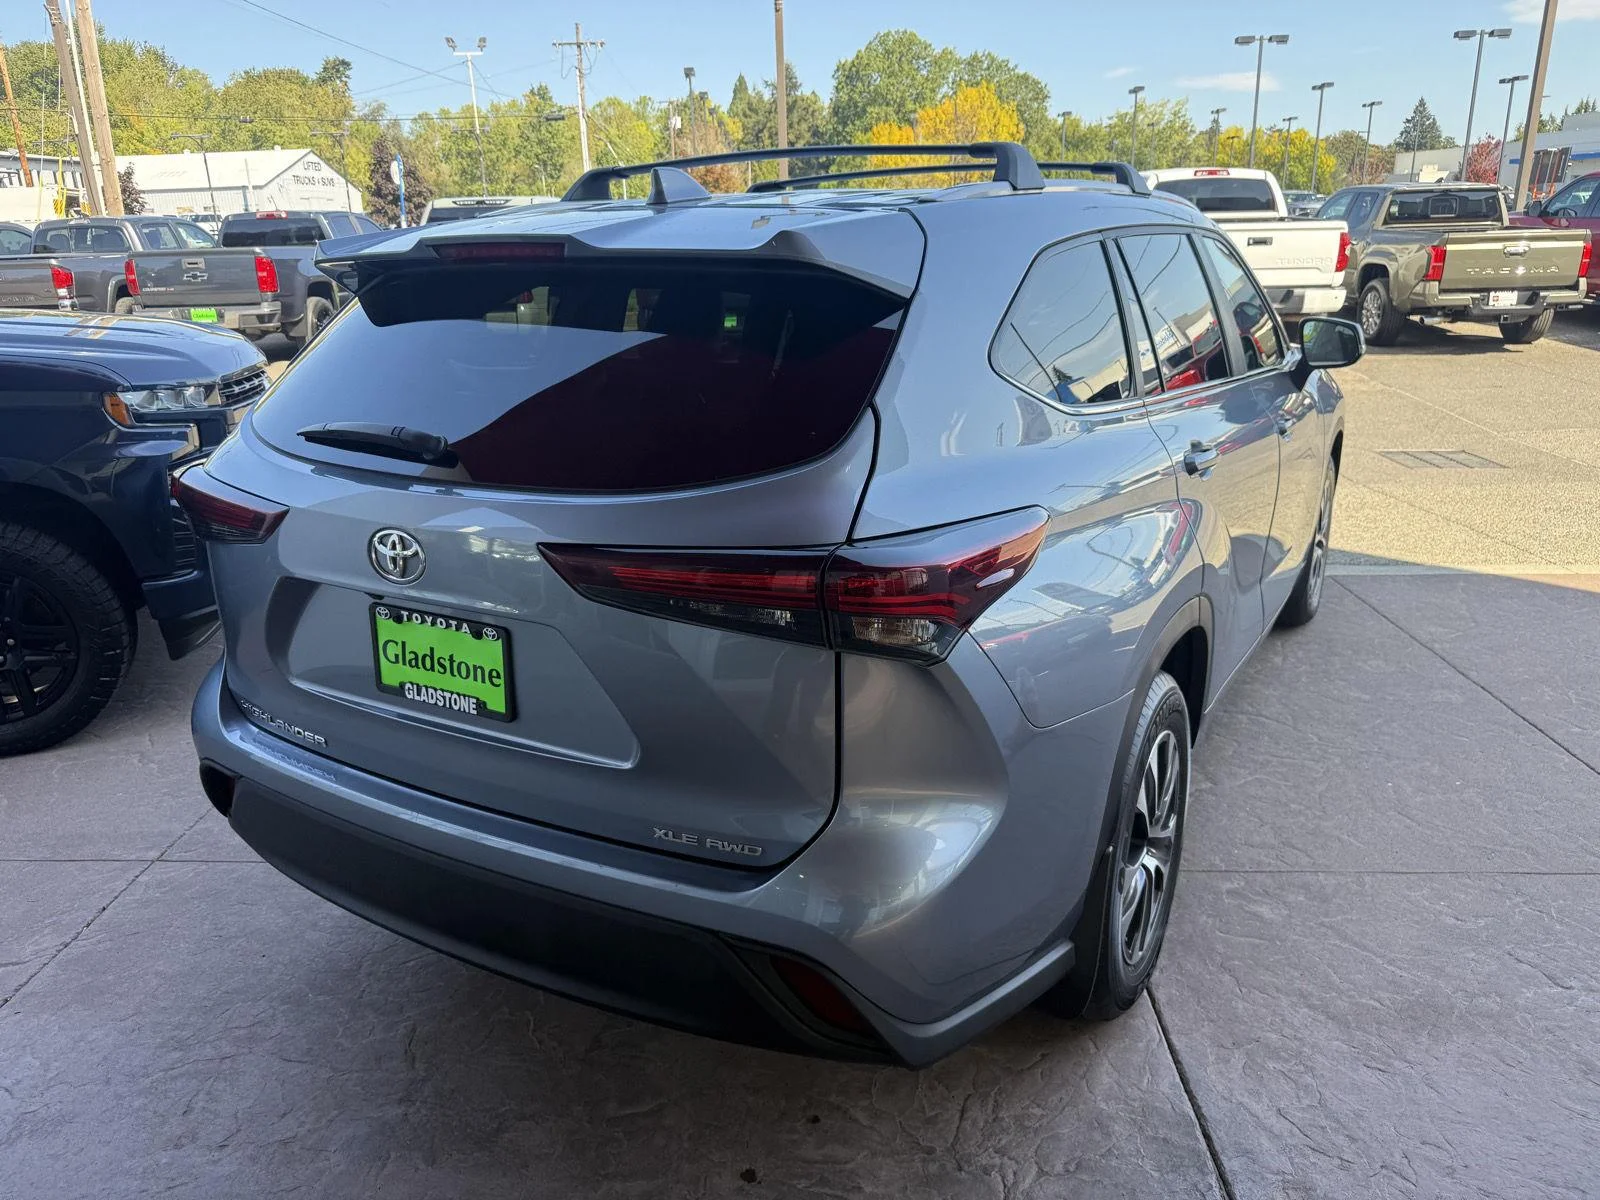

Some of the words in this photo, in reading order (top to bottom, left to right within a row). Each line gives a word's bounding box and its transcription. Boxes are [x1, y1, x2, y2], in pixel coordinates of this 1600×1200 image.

[292, 175, 316, 186] TRUCKS
[303, 161, 321, 171] LIFTED
[400, 611, 470, 634] TOYOTA
[382, 639, 502, 687] Gladstone
[404, 682, 478, 714] GLADSTONE
[241, 699, 327, 748] HIGHLANDER
[652, 827, 699, 846] XLE
[705, 838, 762, 856] AWD
